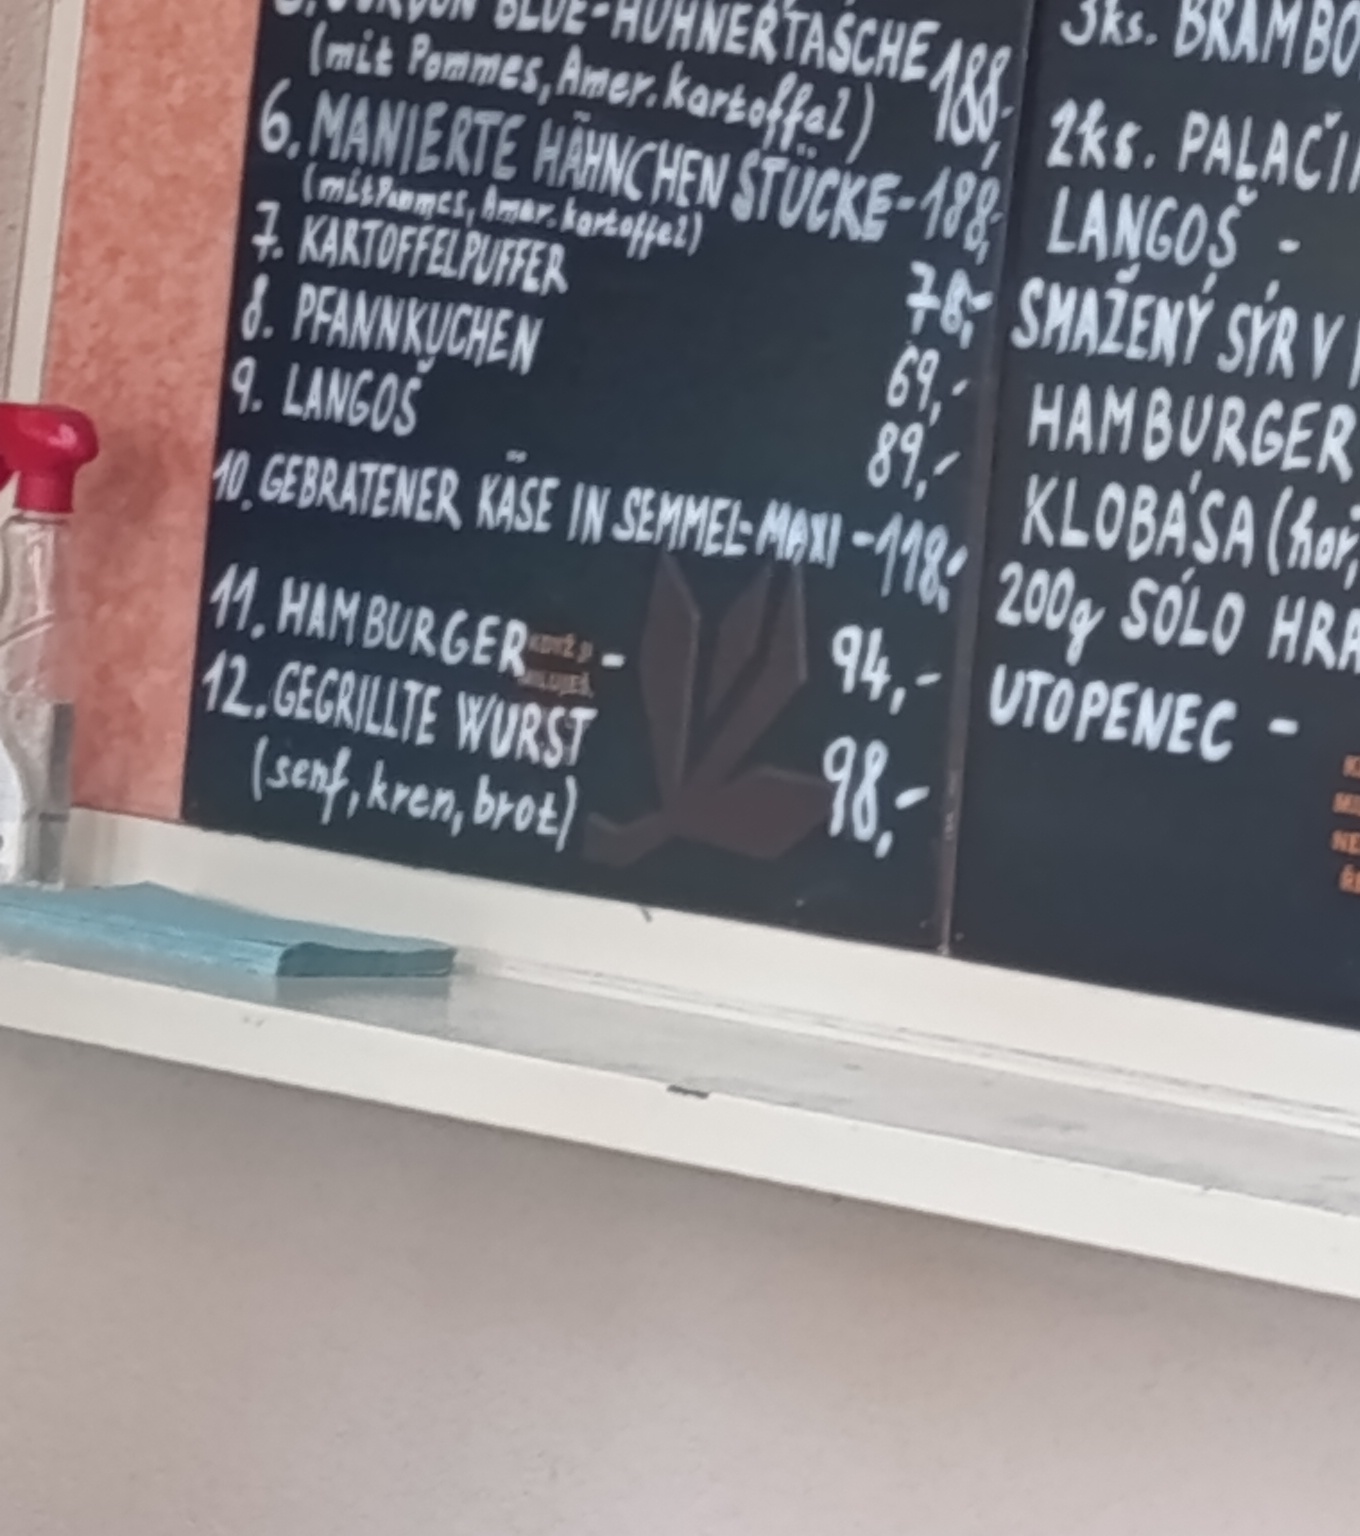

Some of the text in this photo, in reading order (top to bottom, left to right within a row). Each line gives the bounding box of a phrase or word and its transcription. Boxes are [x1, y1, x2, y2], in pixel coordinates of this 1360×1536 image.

[534, 109, 730, 209] HÄHNCHEN
[298, 216, 567, 295] KARTOFFELPUFFER
[1045, 185, 1258, 268] LANGOŠ
[292, 282, 543, 376] PFANNKUCHEN
[1012, 264, 1216, 366] SMAŽENÝ
[1218, 282, 1295, 379] SÝR
[1312, 314, 1344, 380] V
[282, 353, 433, 436] LANGOŠ
[1028, 384, 1358, 482] HAMBURGER
[258, 454, 462, 530] GEBRATENER
[476, 450, 561, 535] KÄSE
[568, 481, 608, 544] IN
[1022, 466, 1255, 568] KLOBÁSA
[278, 577, 529, 677] HAMBURGER
[997, 562, 1106, 664] 200g
[1120, 569, 1247, 657] SÓLO
[203, 653, 268, 720] 12.
[273, 659, 439, 746] GEGRILLTE
[457, 693, 598, 770] WURST
[990, 664, 1238, 763] UTOPENEC
